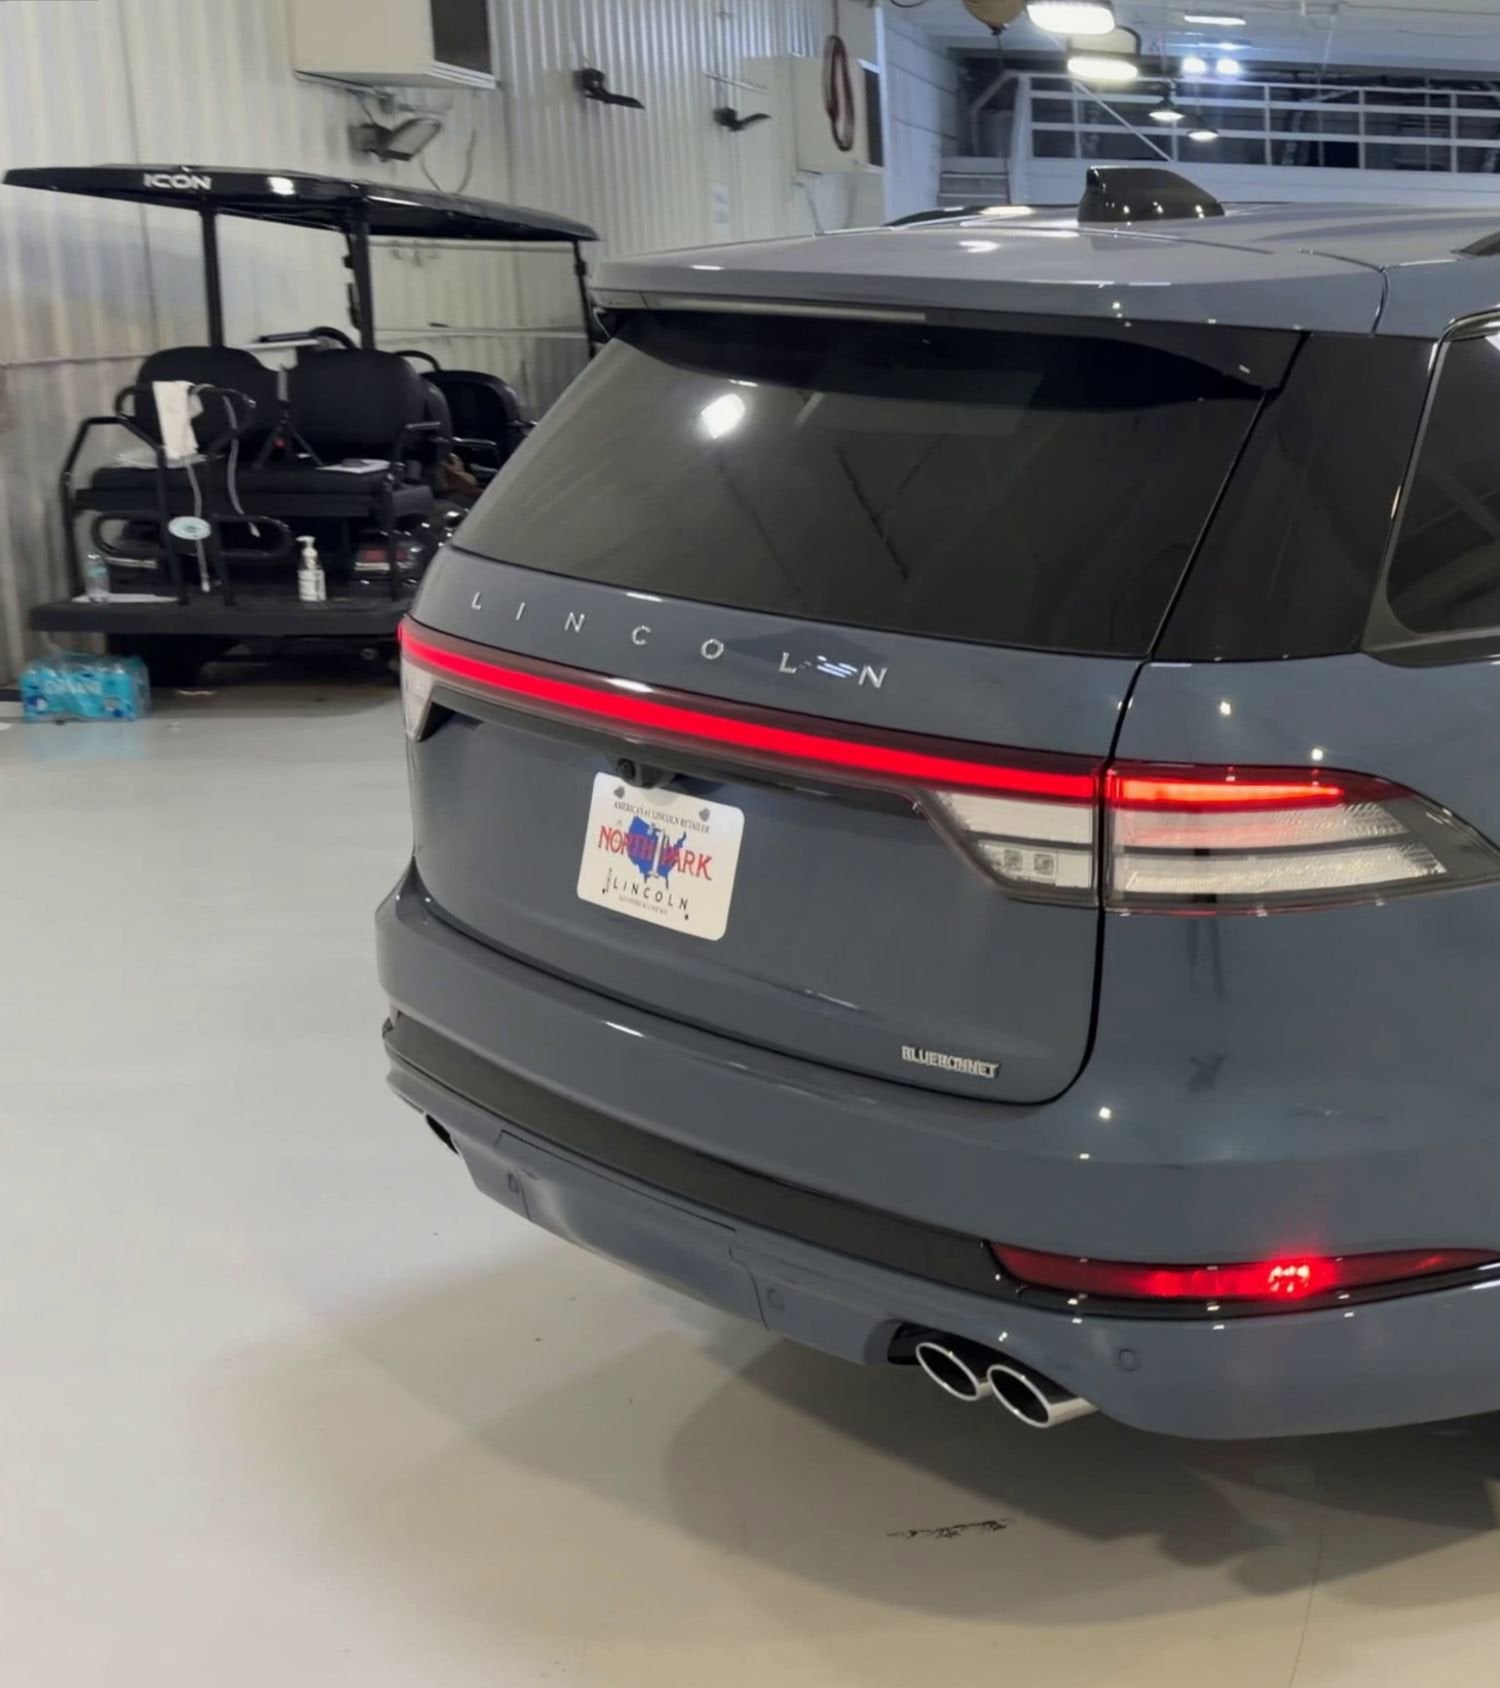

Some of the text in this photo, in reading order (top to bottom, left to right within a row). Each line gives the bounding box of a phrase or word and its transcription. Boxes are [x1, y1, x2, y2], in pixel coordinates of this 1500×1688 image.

[143, 173, 211, 190] ICON
[470, 591, 888, 689] LINCOLN
[652, 809, 680, 825] LINCOLN
[598, 825, 712, 881] NORTH PARK
[613, 877, 688, 911] LINCOLN
[901, 1045, 999, 1079] BLUEBONNET
